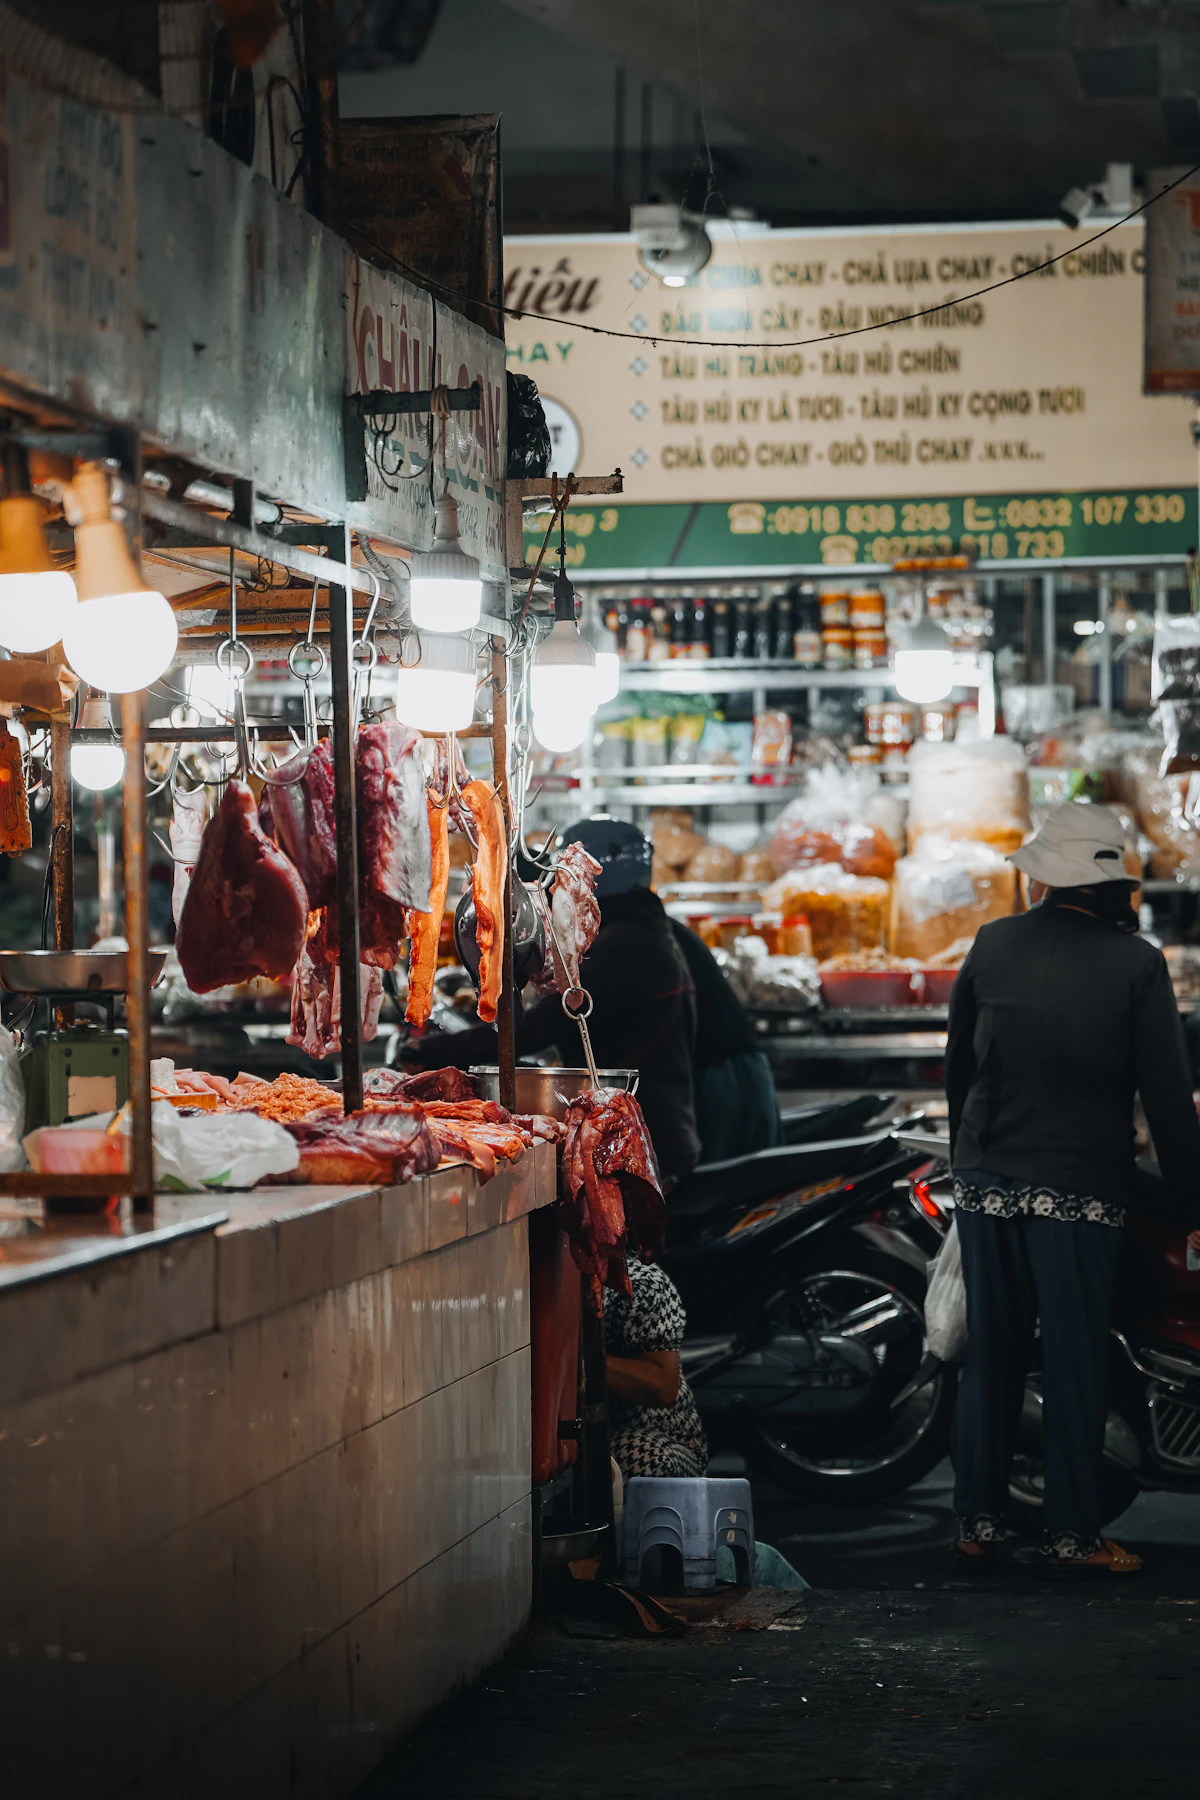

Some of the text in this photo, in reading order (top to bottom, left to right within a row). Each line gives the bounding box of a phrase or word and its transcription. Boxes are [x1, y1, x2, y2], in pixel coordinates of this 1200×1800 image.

[770, 260, 826, 289] CHAY
[842, 249, 888, 286] CHẢ
[937, 254, 995, 283] CHAY
[505, 341, 574, 362] HAY
[660, 434, 706, 469] CHẢ
[755, 439, 811, 468] CHAY
[916, 437, 974, 464] CHAY
[901, 502, 951, 531] 295
[1080, 495, 1128, 525] 107
[1134, 494, 1185, 523] 330
[1015, 530, 1065, 558] 733
